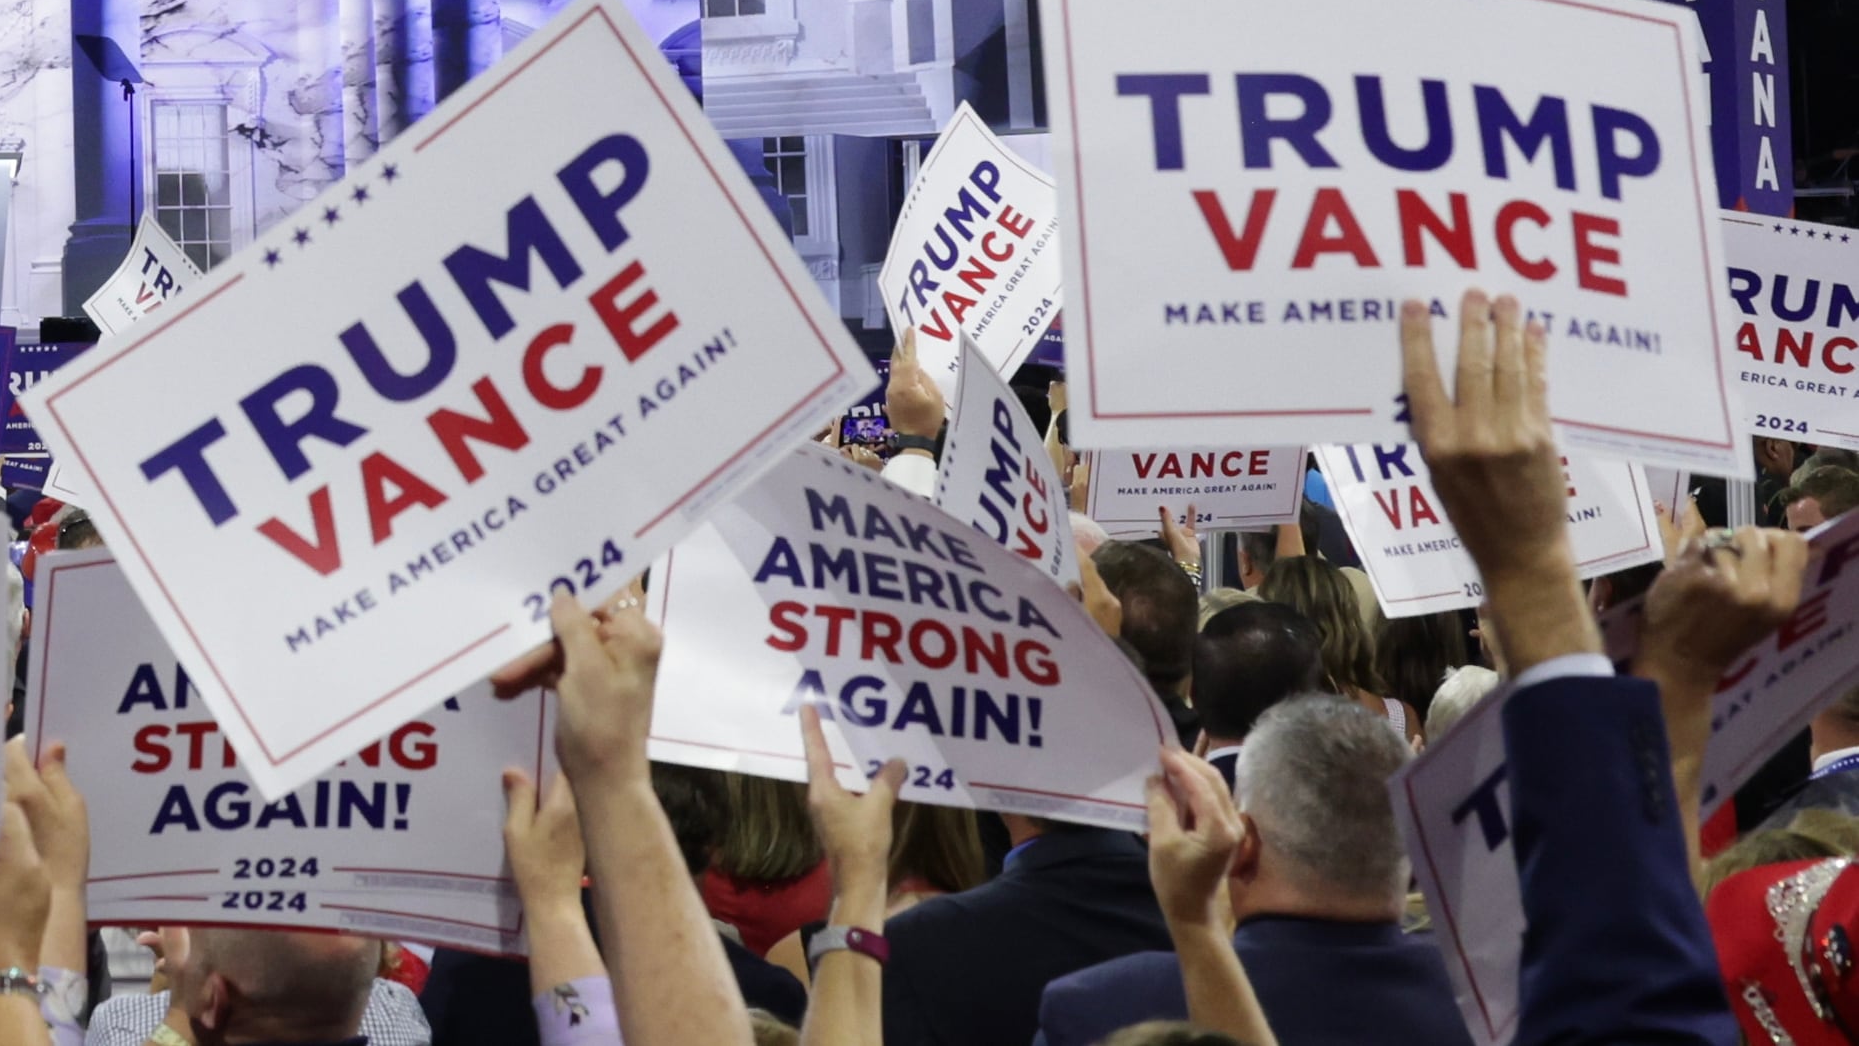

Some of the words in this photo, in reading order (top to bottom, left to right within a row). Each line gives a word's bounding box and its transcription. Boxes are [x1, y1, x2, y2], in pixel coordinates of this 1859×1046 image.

[1115, 73, 1661, 201] TRUMP
[899, 160, 1002, 327] TRUMP
[1191, 187, 1630, 296] VANCE
[919, 204, 1035, 342] VANCE
[971, 294, 1007, 340] AMERICA
[1006, 258, 1034, 292] GREAT
[1727, 266, 1859, 328] RUM
[138, 132, 653, 528] TRUMP
[1022, 297, 1053, 336] 2024
[1043, 334, 1065, 343] AGA
[1164, 301, 1266, 327] MAKE
[1282, 298, 1448, 325] AMERIA
[1566, 317, 1662, 354] AGAIN!
[1737, 322, 1859, 374] ANC
[1741, 371, 1788, 388] ERICA
[1795, 380, 1847, 396] GREAT
[256, 259, 682, 578] VANCE
[1755, 414, 1808, 434] 2024
[28, 443, 47, 451] 202
[972, 397, 1021, 546] UMP
[1131, 450, 1270, 479] VANCE
[283, 589, 378, 656] MAKE
[387, 494, 527, 596] AMERICA
[534, 419, 627, 496] GREAT
[636, 327, 738, 421] AGAIN!
[1014, 456, 1048, 560] NCE
[1117, 487, 1148, 495] MAKE
[1152, 486, 1200, 495] AMERICA
[1204, 484, 1237, 494] GREAT
[1241, 482, 1277, 492] AGAIN!
[805, 487, 986, 573] MAKE
[1179, 513, 1212, 524] 224
[1383, 544, 1415, 558] MAKE
[1417, 538, 1462, 553] AMERIC
[1566, 506, 1603, 525] AIN!
[753, 536, 1062, 640] AMERICA
[1464, 583, 1482, 597] 20
[766, 600, 1061, 687] STRONG
[781, 668, 1044, 749] AGAIN!
[131, 720, 439, 774] STG
[149, 781, 411, 834] AGAIN!
[233, 857, 319, 879] 2024
[221, 891, 307, 913] 2024
